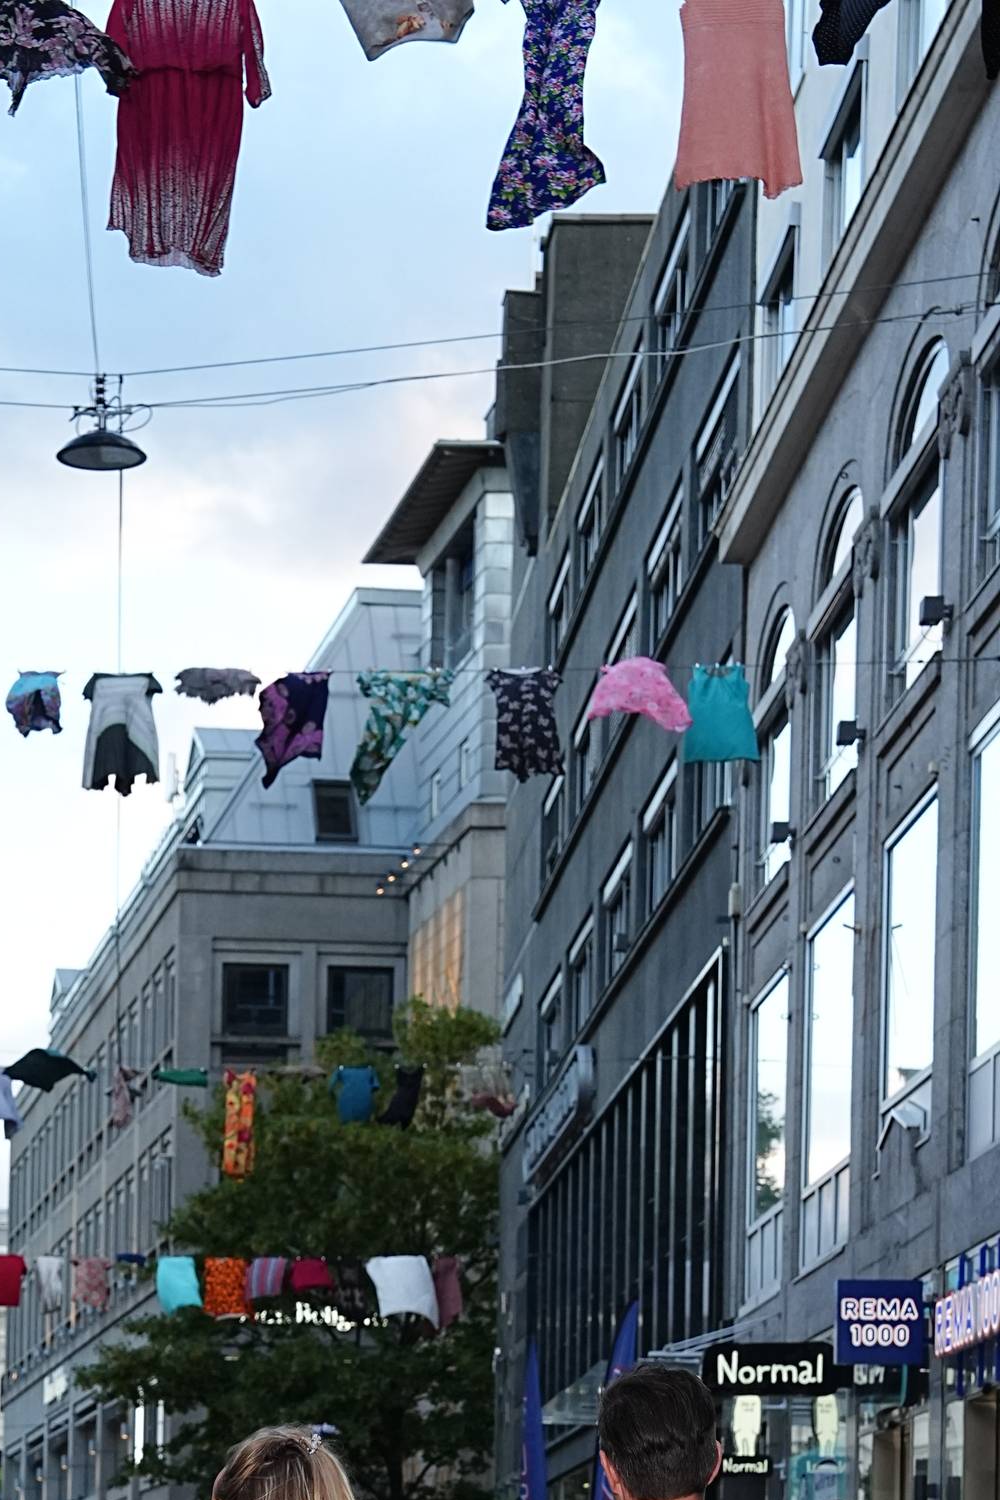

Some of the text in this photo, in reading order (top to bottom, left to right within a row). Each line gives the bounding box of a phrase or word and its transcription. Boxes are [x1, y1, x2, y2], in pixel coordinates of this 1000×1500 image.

[841, 1298, 919, 1321] REMA
[935, 1268, 1000, 1356] REMA 100
[850, 1323, 910, 1347] 1000
[717, 1350, 824, 1386] Normal
[722, 1457, 768, 1474] Normal
